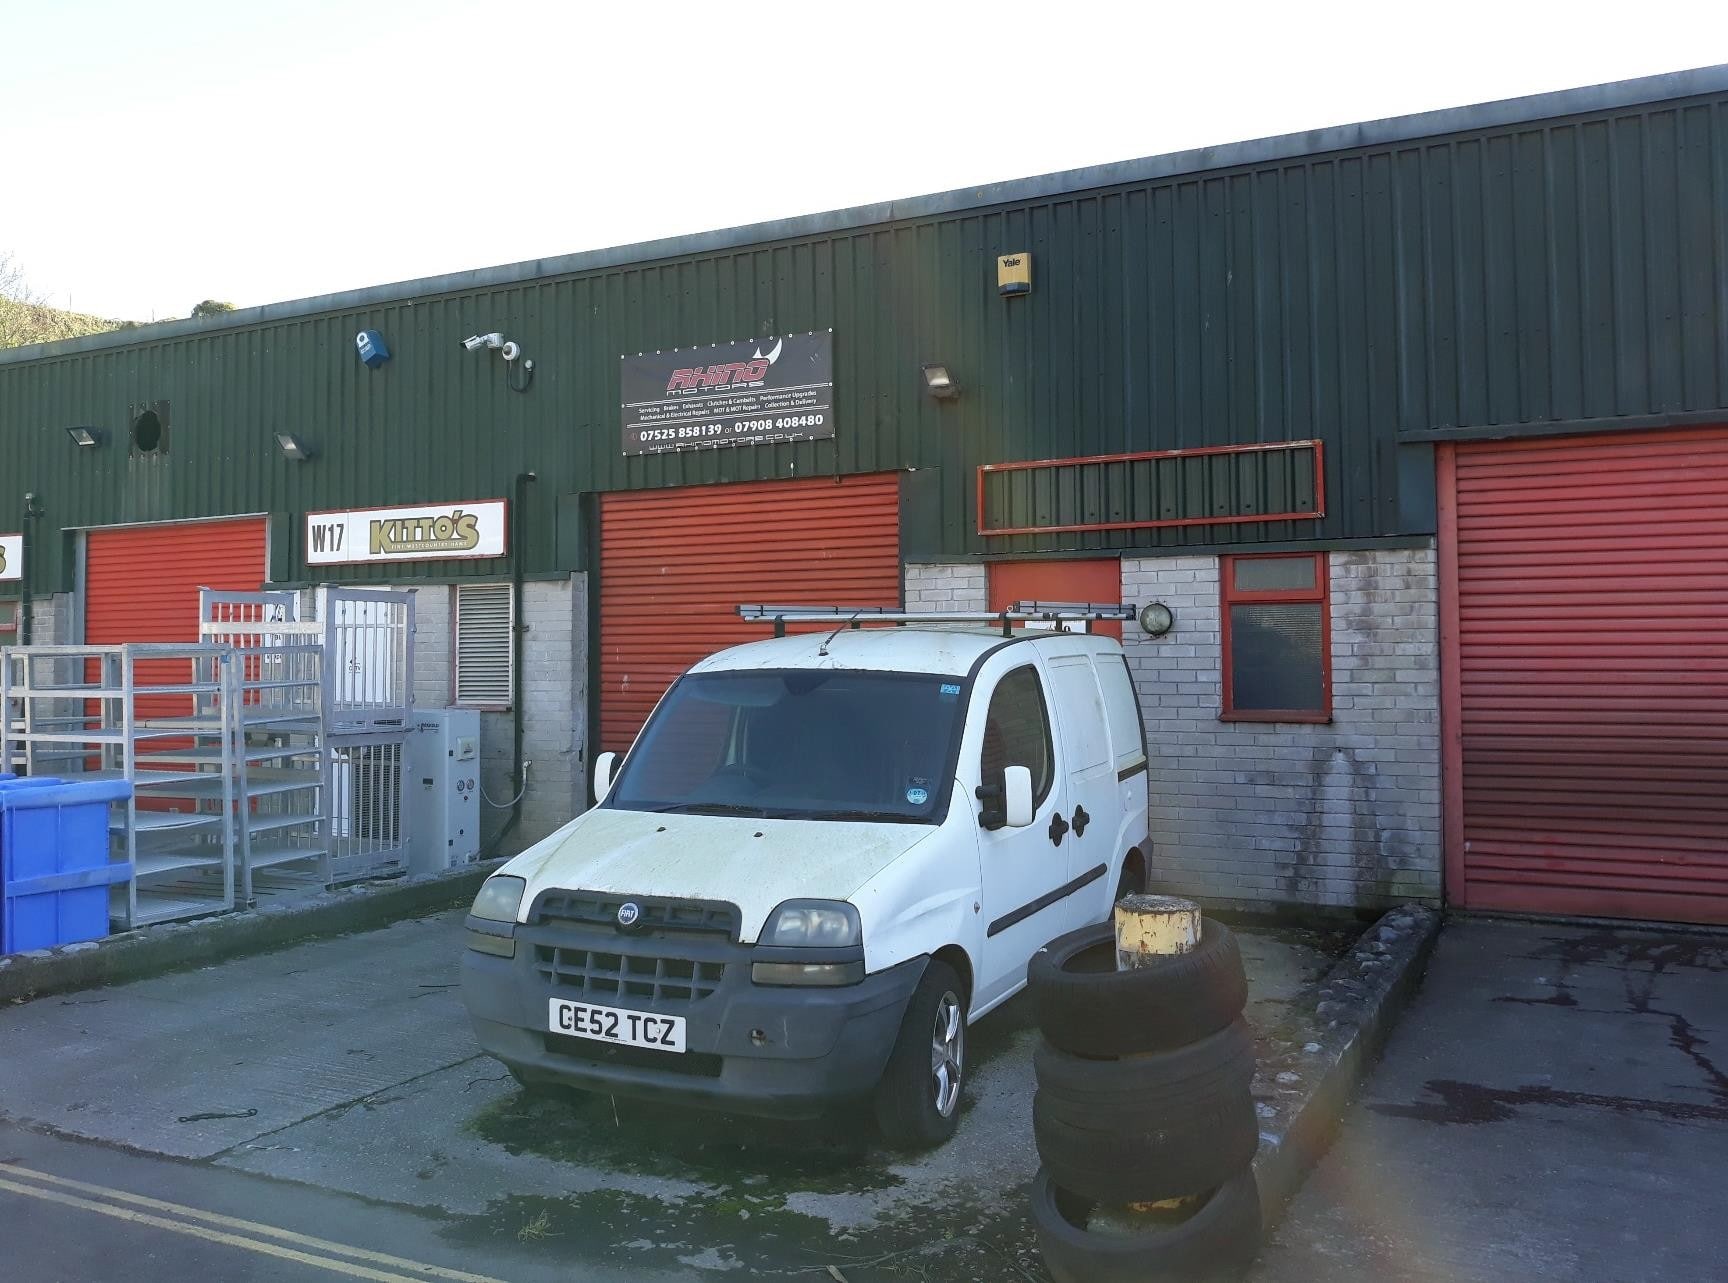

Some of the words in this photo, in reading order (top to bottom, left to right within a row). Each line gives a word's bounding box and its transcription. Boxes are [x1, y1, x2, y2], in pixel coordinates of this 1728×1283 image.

[1003, 258, 1021, 268] Yale
[666, 359, 770, 390] RHINO
[666, 381, 765, 396] MOTORS
[707, 399, 728, 407] Clutches
[760, 393, 792, 401] Performance
[792, 390, 817, 399] Upgrades
[670, 410, 692, 418] Electrical
[692, 409, 710, 417] Repairs
[743, 404, 760, 412] Repairs
[765, 400, 790, 408] Collection
[795, 398, 817, 406] Delivery
[640, 429, 676, 441] 07525
[678, 424, 722, 438] 858139
[734, 419, 773, 433] 07908
[775, 414, 824, 429] 408480
[311, 523, 345, 553] W17
[369, 510, 480, 555] KITTO'S
[621, 909, 635, 918] FIAT
[559, 1004, 619, 1039] CE52
[626, 1014, 676, 1047] TCZ
